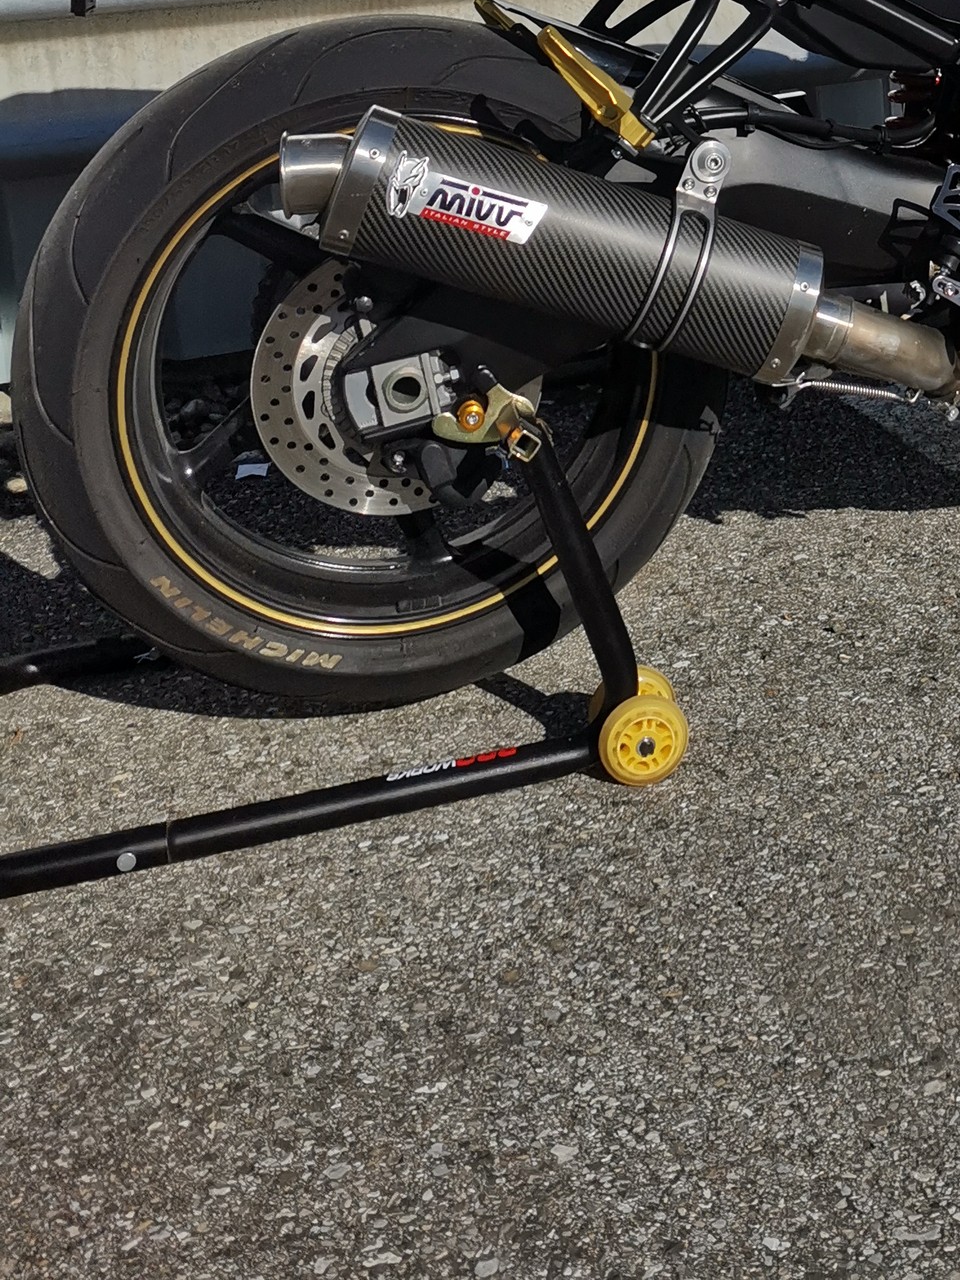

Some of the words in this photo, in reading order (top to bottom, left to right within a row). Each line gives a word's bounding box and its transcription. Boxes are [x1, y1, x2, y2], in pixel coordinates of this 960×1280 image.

[424, 209, 468, 226] ITALIAN
[473, 223, 507, 237] STYLE
[150, 575, 343, 669] MICHELIN
